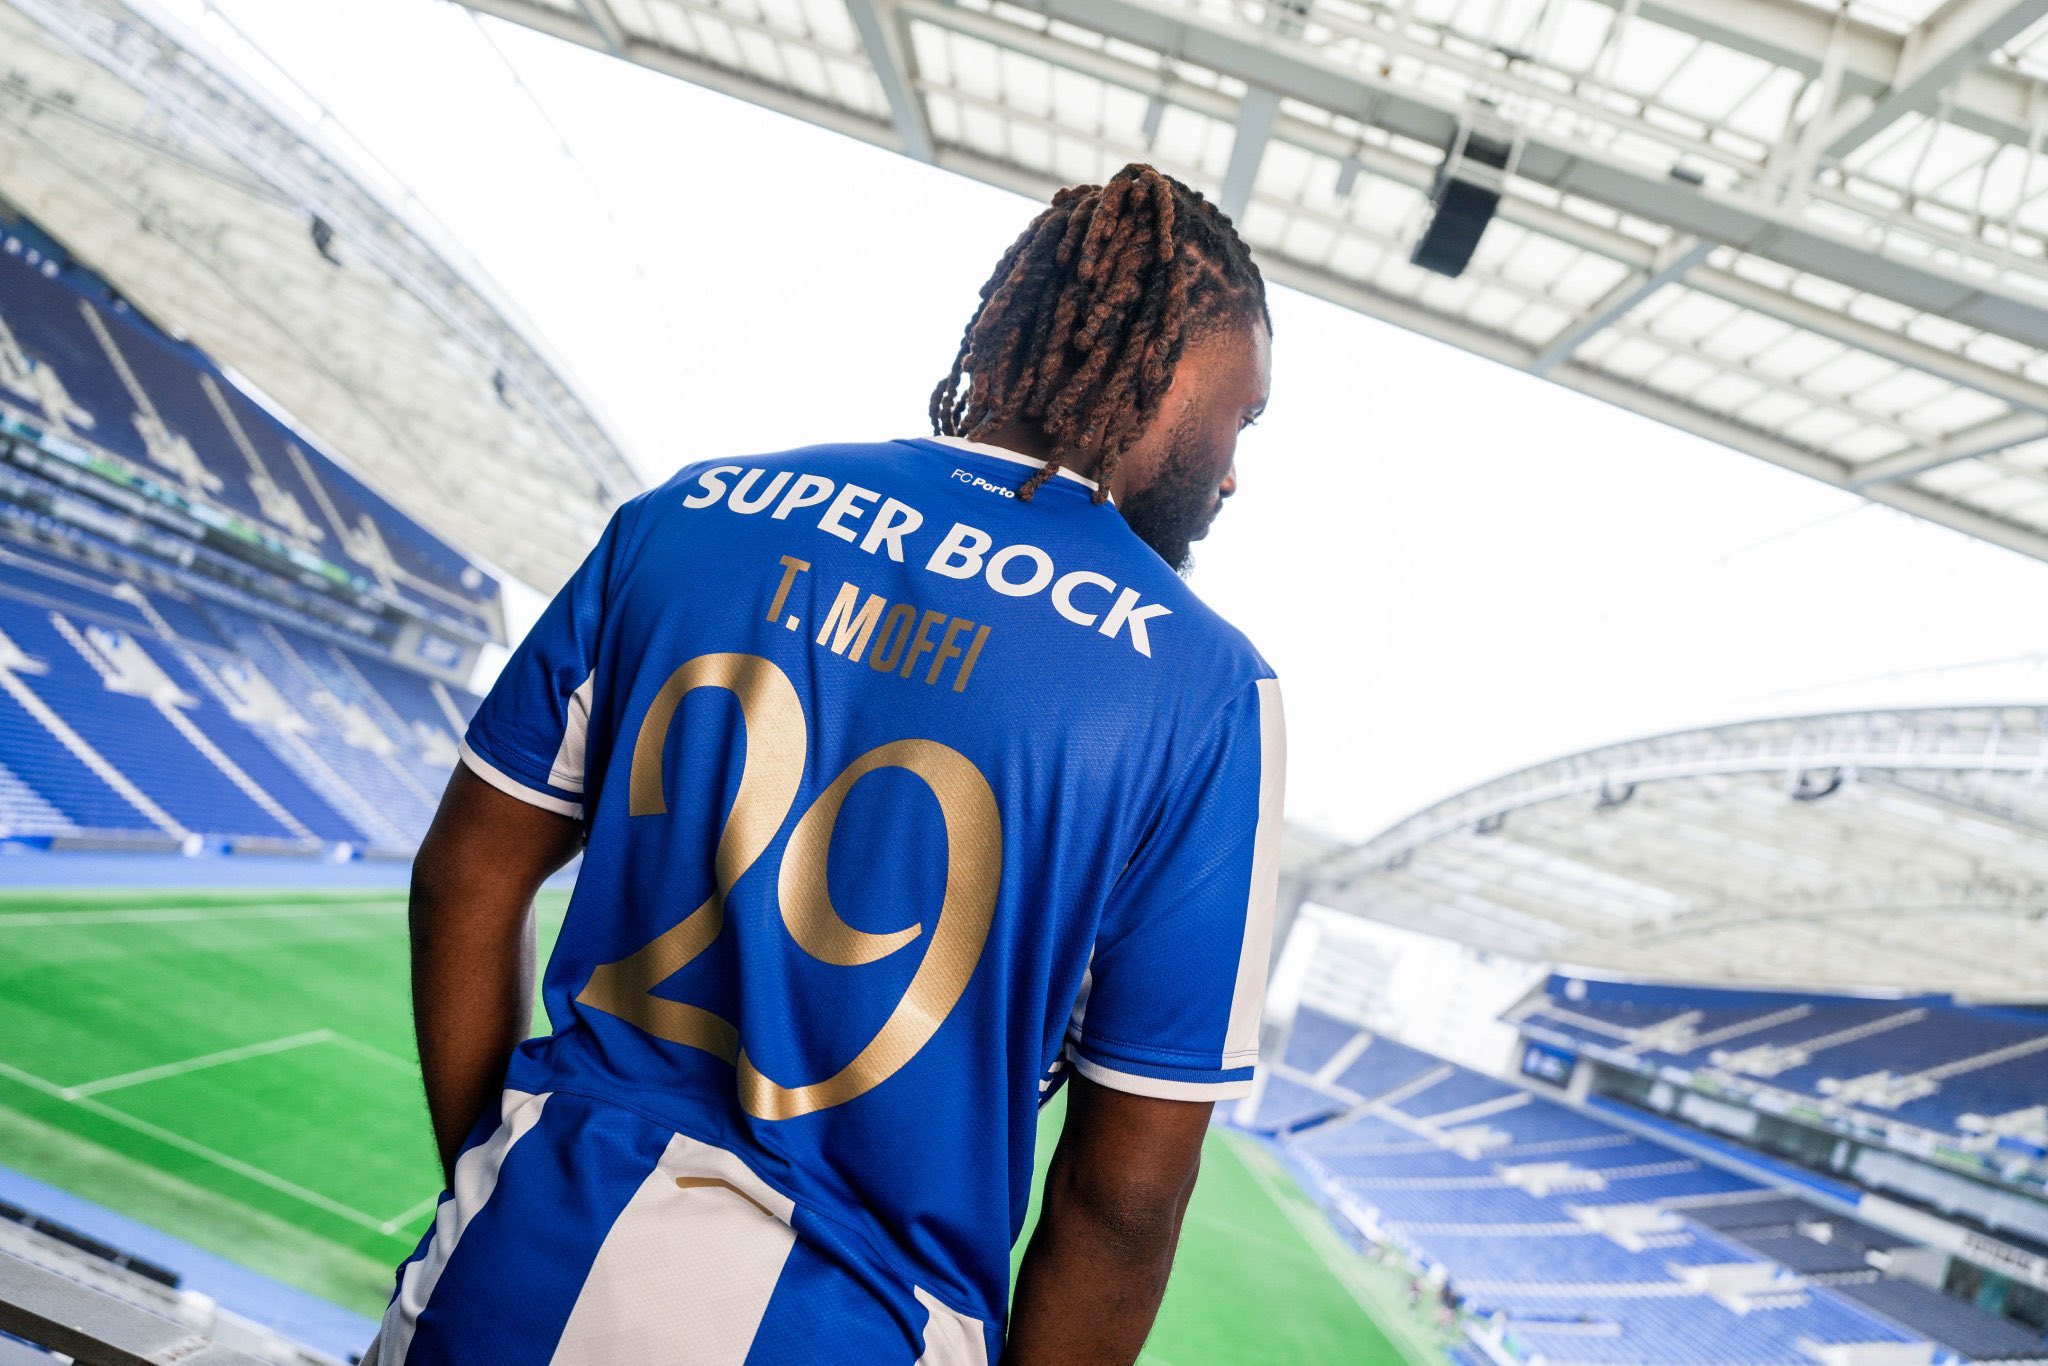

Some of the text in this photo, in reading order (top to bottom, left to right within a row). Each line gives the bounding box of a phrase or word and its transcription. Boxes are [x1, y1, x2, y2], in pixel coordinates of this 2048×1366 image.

[683, 465, 1173, 658] SUPER BOCK
[951, 469, 1016, 498] FC Porto
[766, 555, 992, 693] T. MOFFI
[575, 653, 1002, 1121] 29
